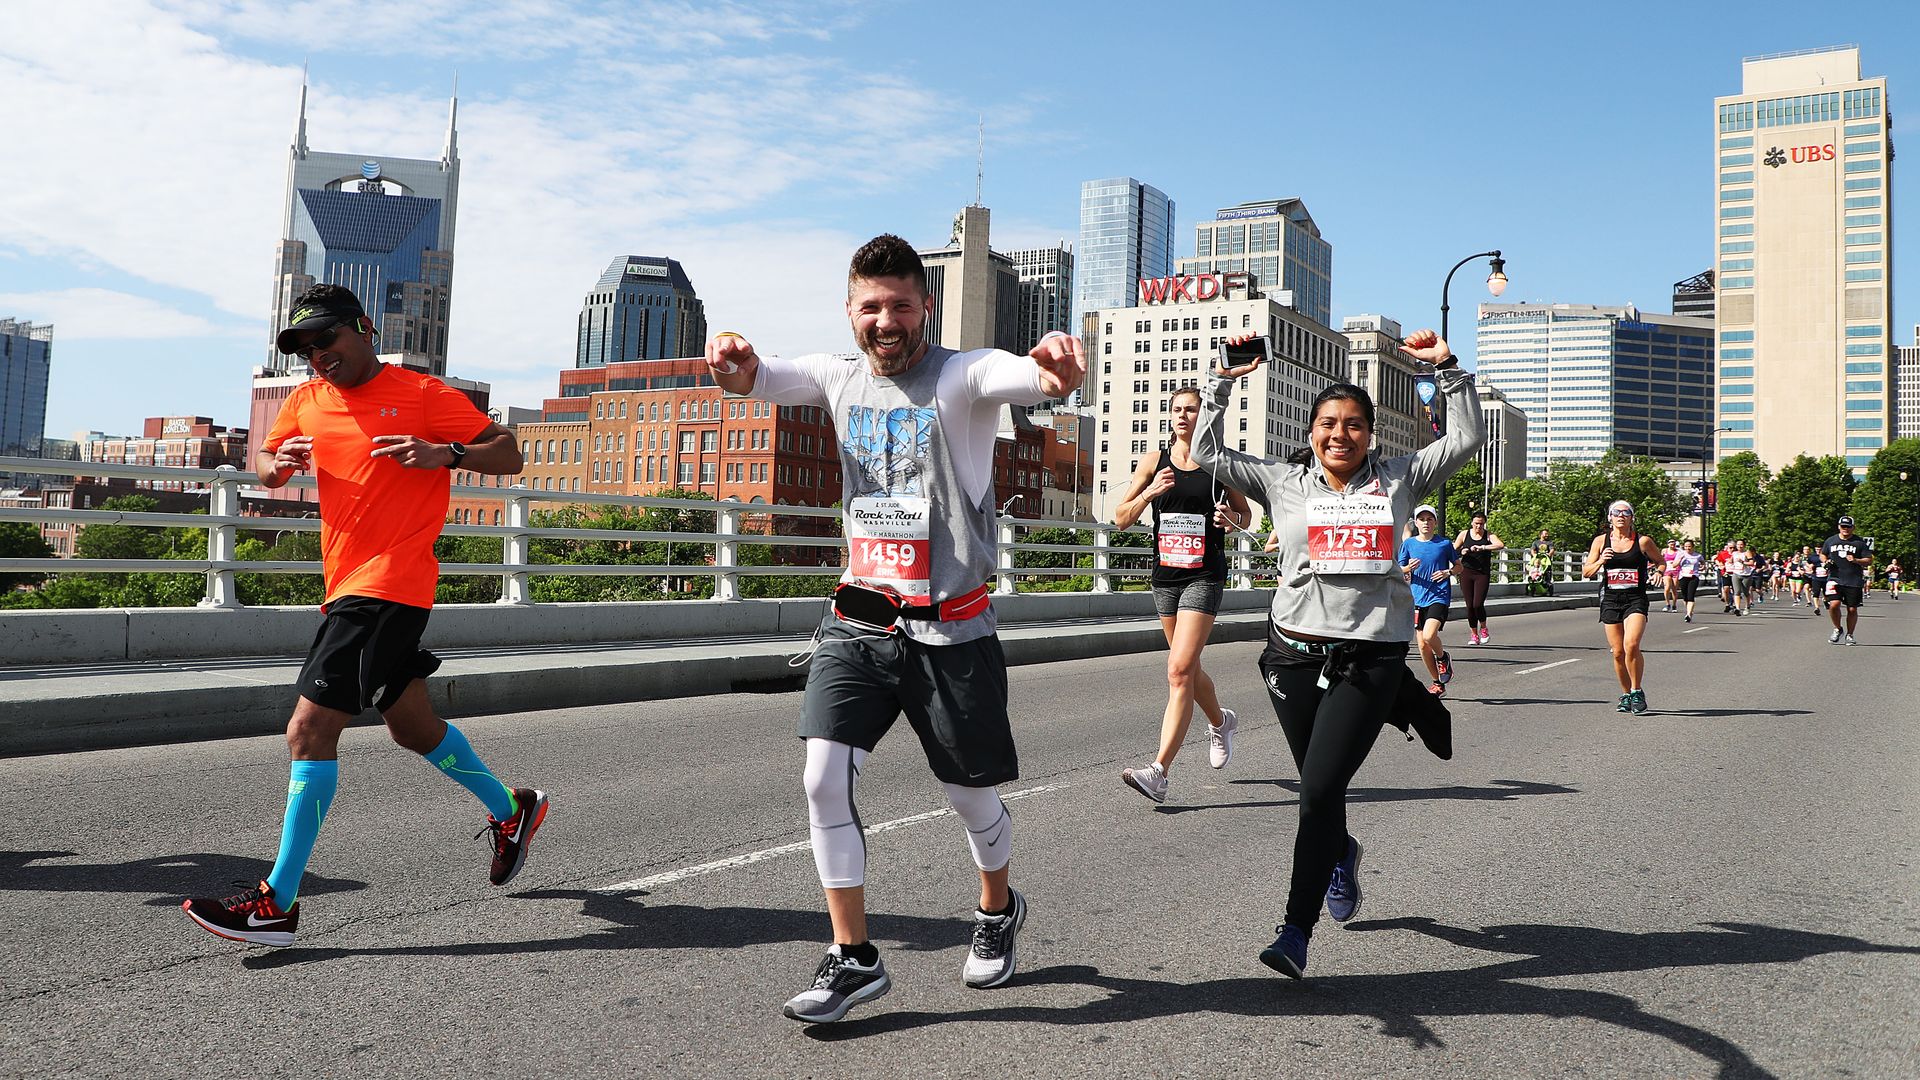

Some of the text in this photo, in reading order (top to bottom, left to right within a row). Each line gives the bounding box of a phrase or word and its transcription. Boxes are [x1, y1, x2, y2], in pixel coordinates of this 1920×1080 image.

[1791, 145, 1836, 163] UBS
[1139, 271, 1248, 304] WKDF
[1160, 535, 1202, 549] 15286
[1323, 528, 1378, 549] 1751
[860, 541, 916, 567] 1459
[1319, 550, 1383, 558] CORRE CHAPIZ
[1830, 544, 1857, 554] NASH
[876, 568, 896, 576] ERIC
